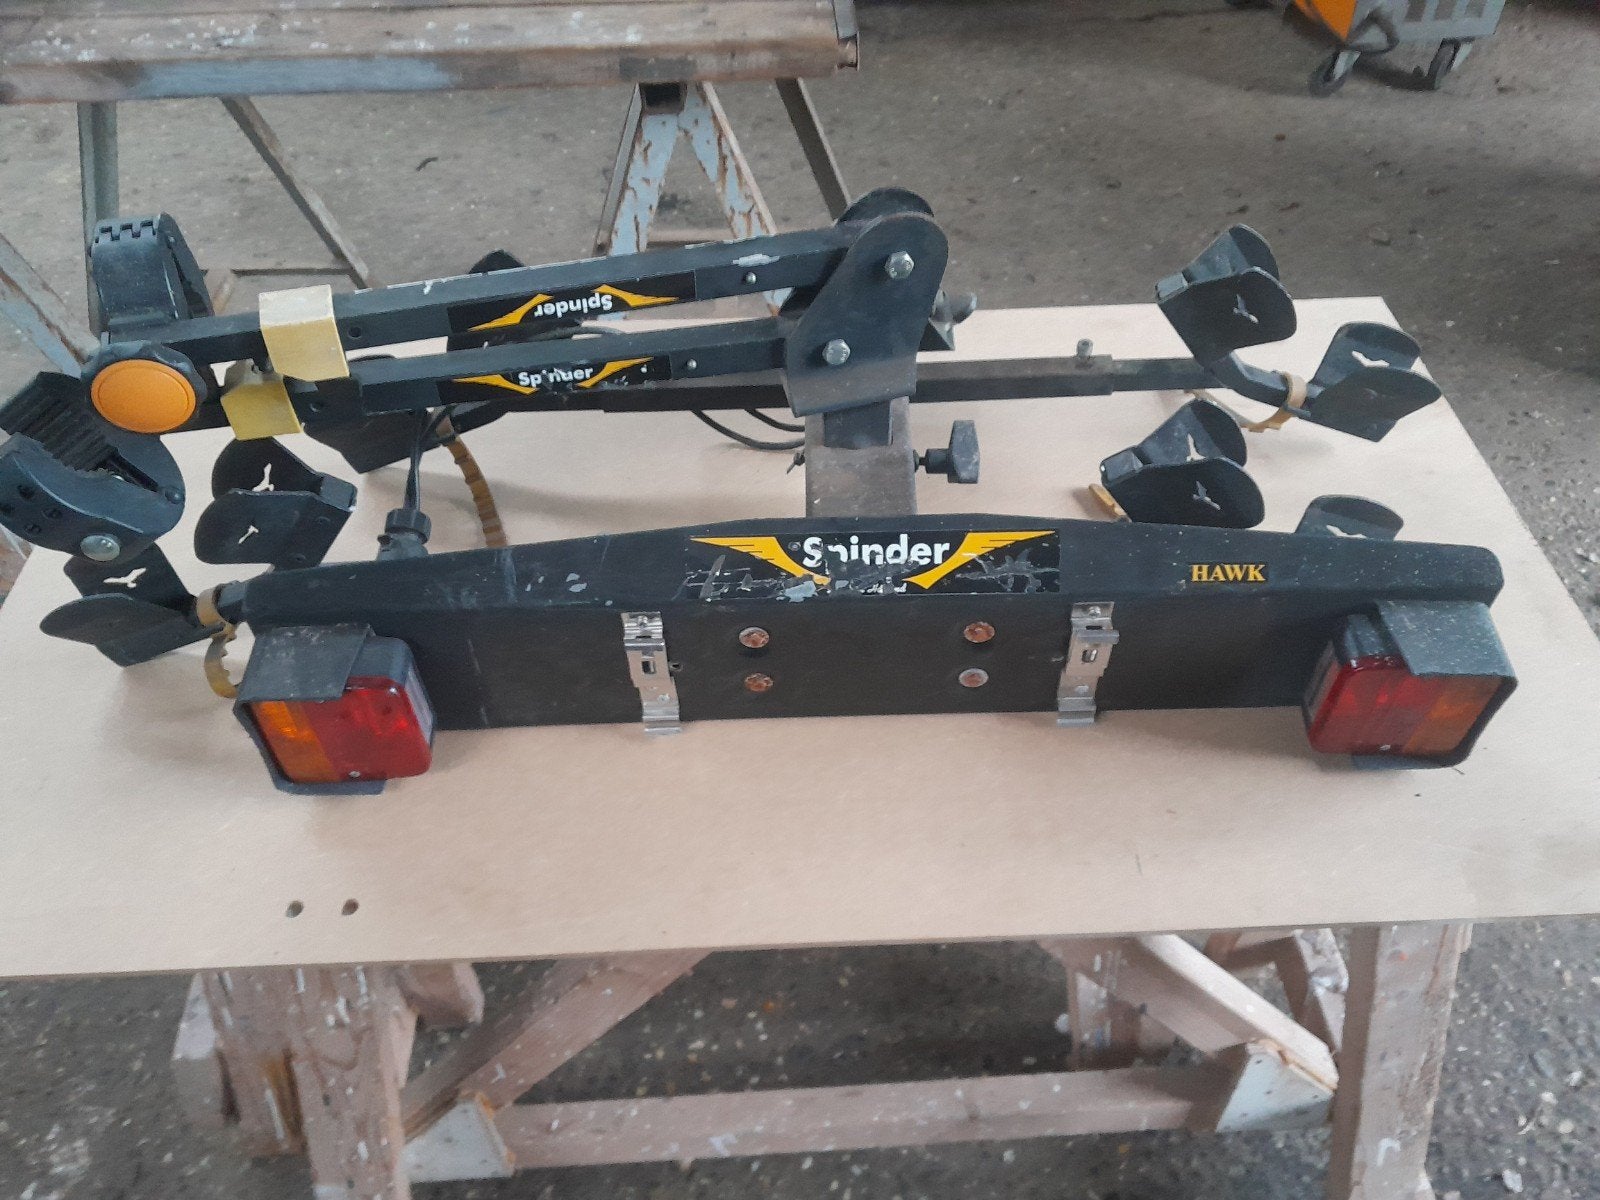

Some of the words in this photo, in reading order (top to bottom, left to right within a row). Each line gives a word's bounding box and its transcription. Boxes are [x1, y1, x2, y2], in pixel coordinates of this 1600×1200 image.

[533, 292, 613, 319] Spinder
[518, 367, 594, 388] Spnder
[1190, 564, 1267, 582] HAWK
